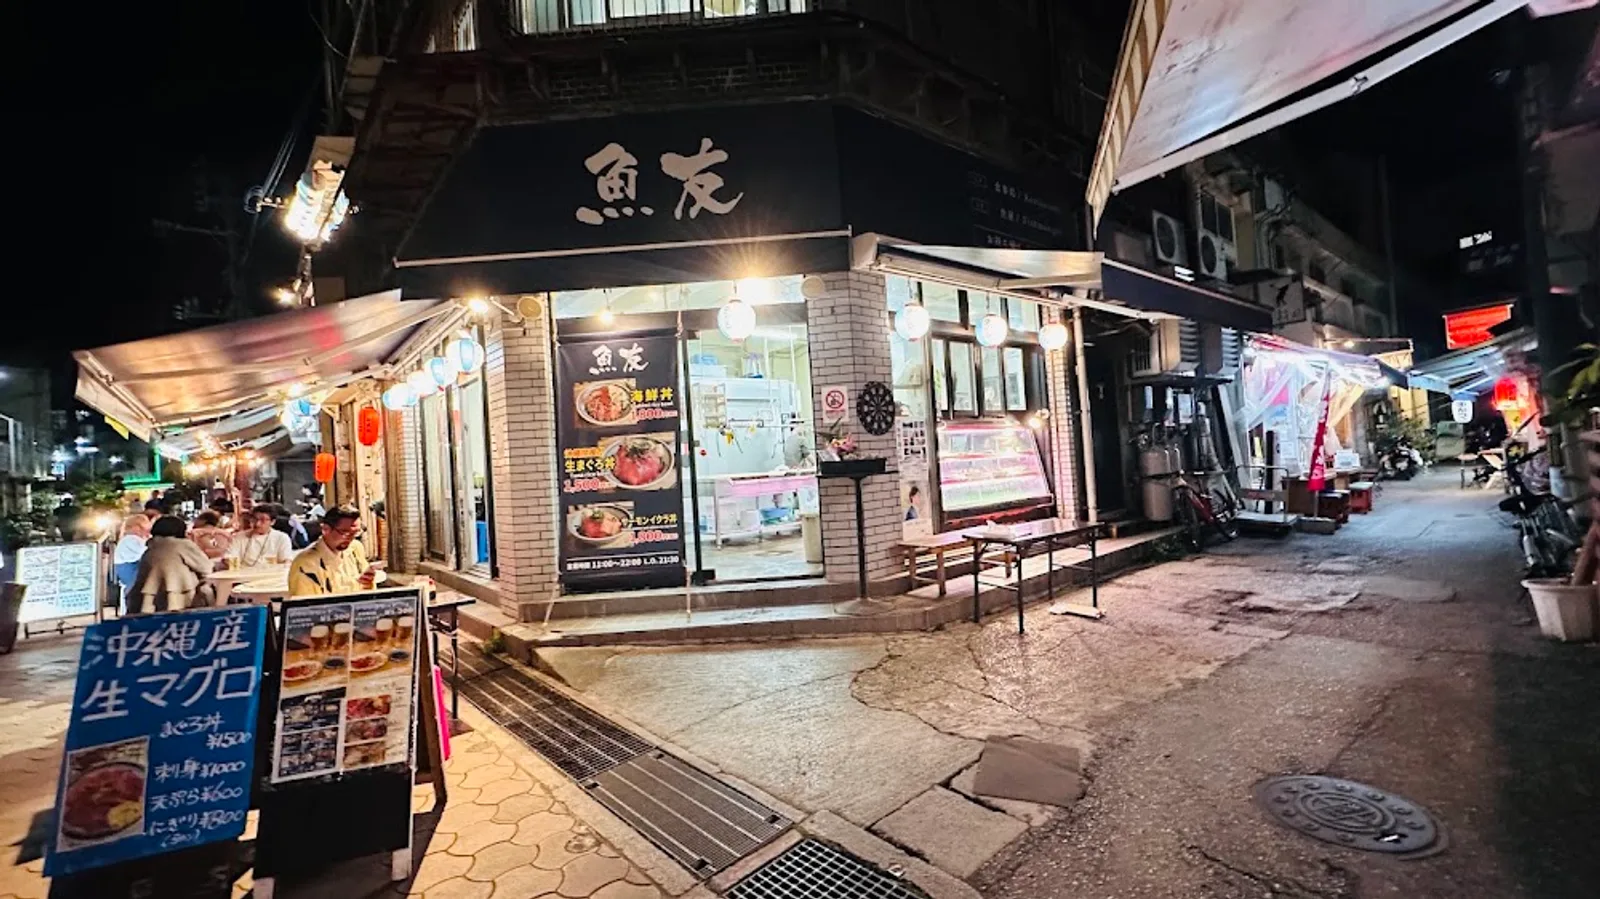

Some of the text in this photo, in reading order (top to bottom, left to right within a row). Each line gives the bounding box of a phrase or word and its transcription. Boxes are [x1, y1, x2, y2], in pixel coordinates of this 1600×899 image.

[575, 137, 744, 225] 魚友
[589, 343, 649, 375] 魚友
[630, 387, 674, 403] 海鮮丼
[564, 456, 616, 473] 生まぐろ丼
[80, 610, 251, 670] 沖縄産
[80, 657, 258, 724] 生マグロ
[160, 711, 225, 738] まぐろ丼
[206, 731, 252, 750] ¥1500
